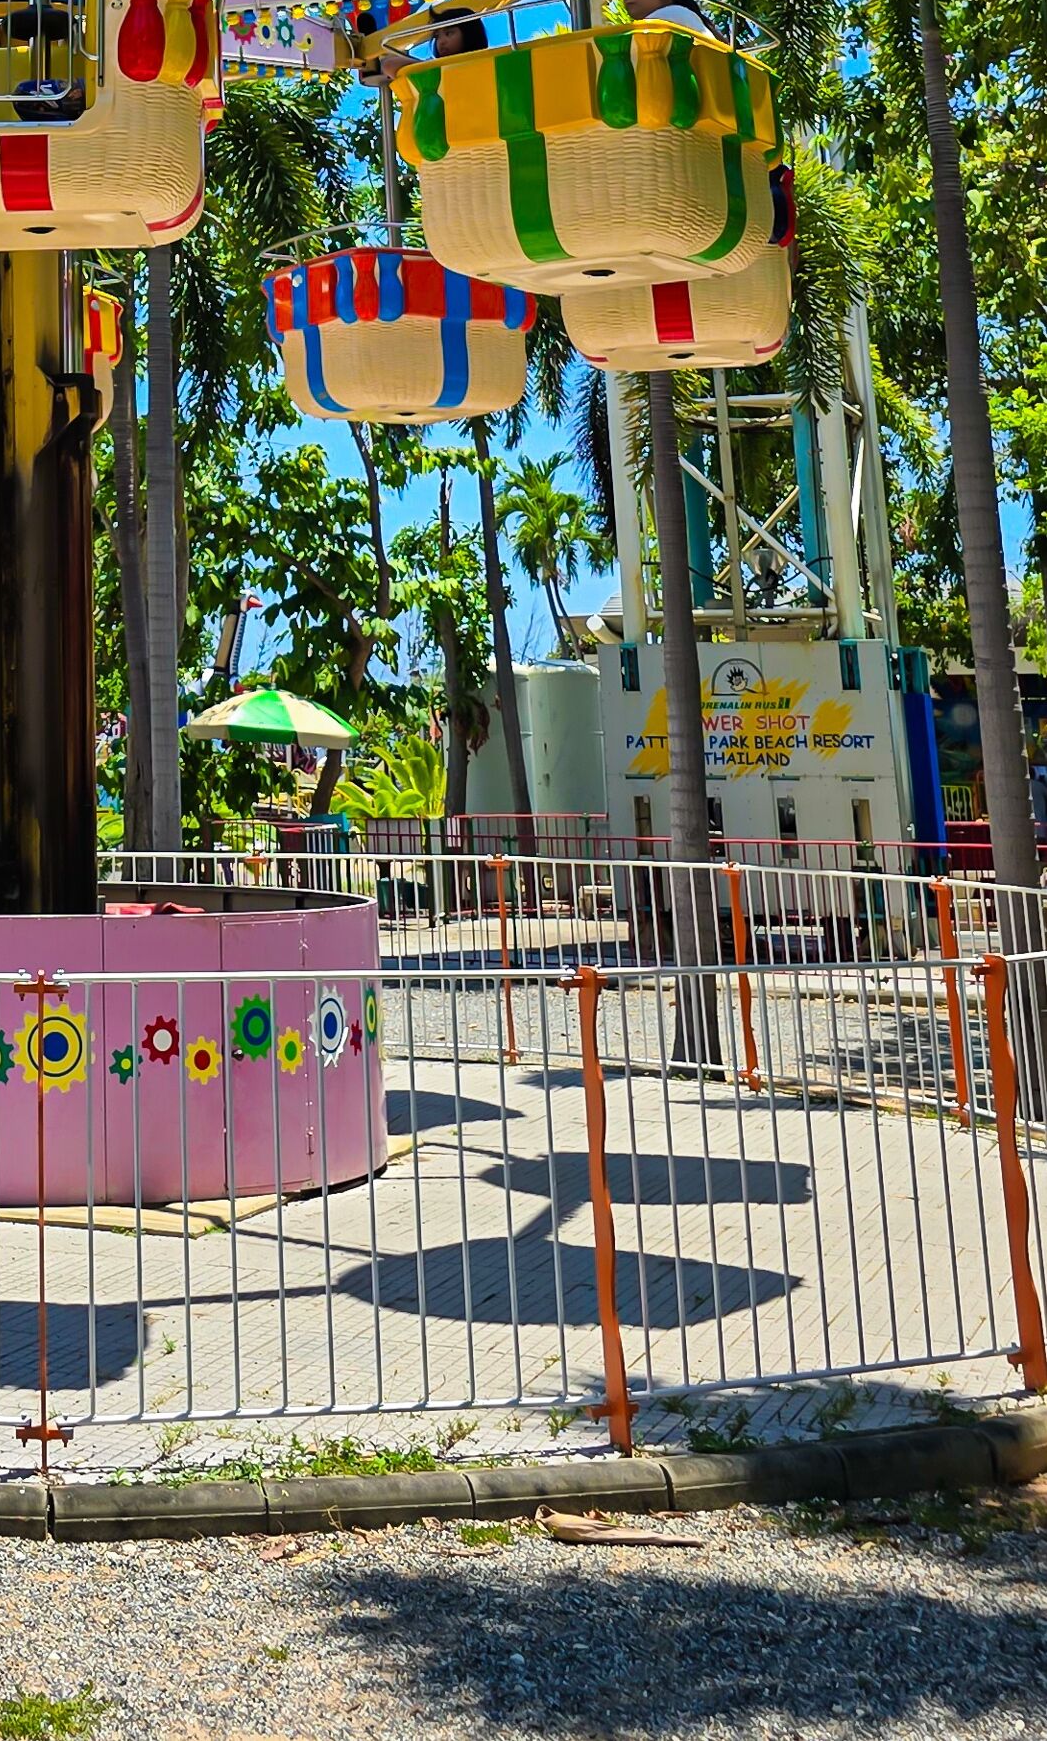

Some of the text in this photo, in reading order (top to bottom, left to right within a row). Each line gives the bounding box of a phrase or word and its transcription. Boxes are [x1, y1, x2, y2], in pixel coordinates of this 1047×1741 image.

[701, 701, 752, 710] DRENALIN
[702, 715, 810, 731] WER SHOT
[626, 733, 875, 749] PATT PARK BEACH RESORT
[704, 751, 791, 766] THAILAND
